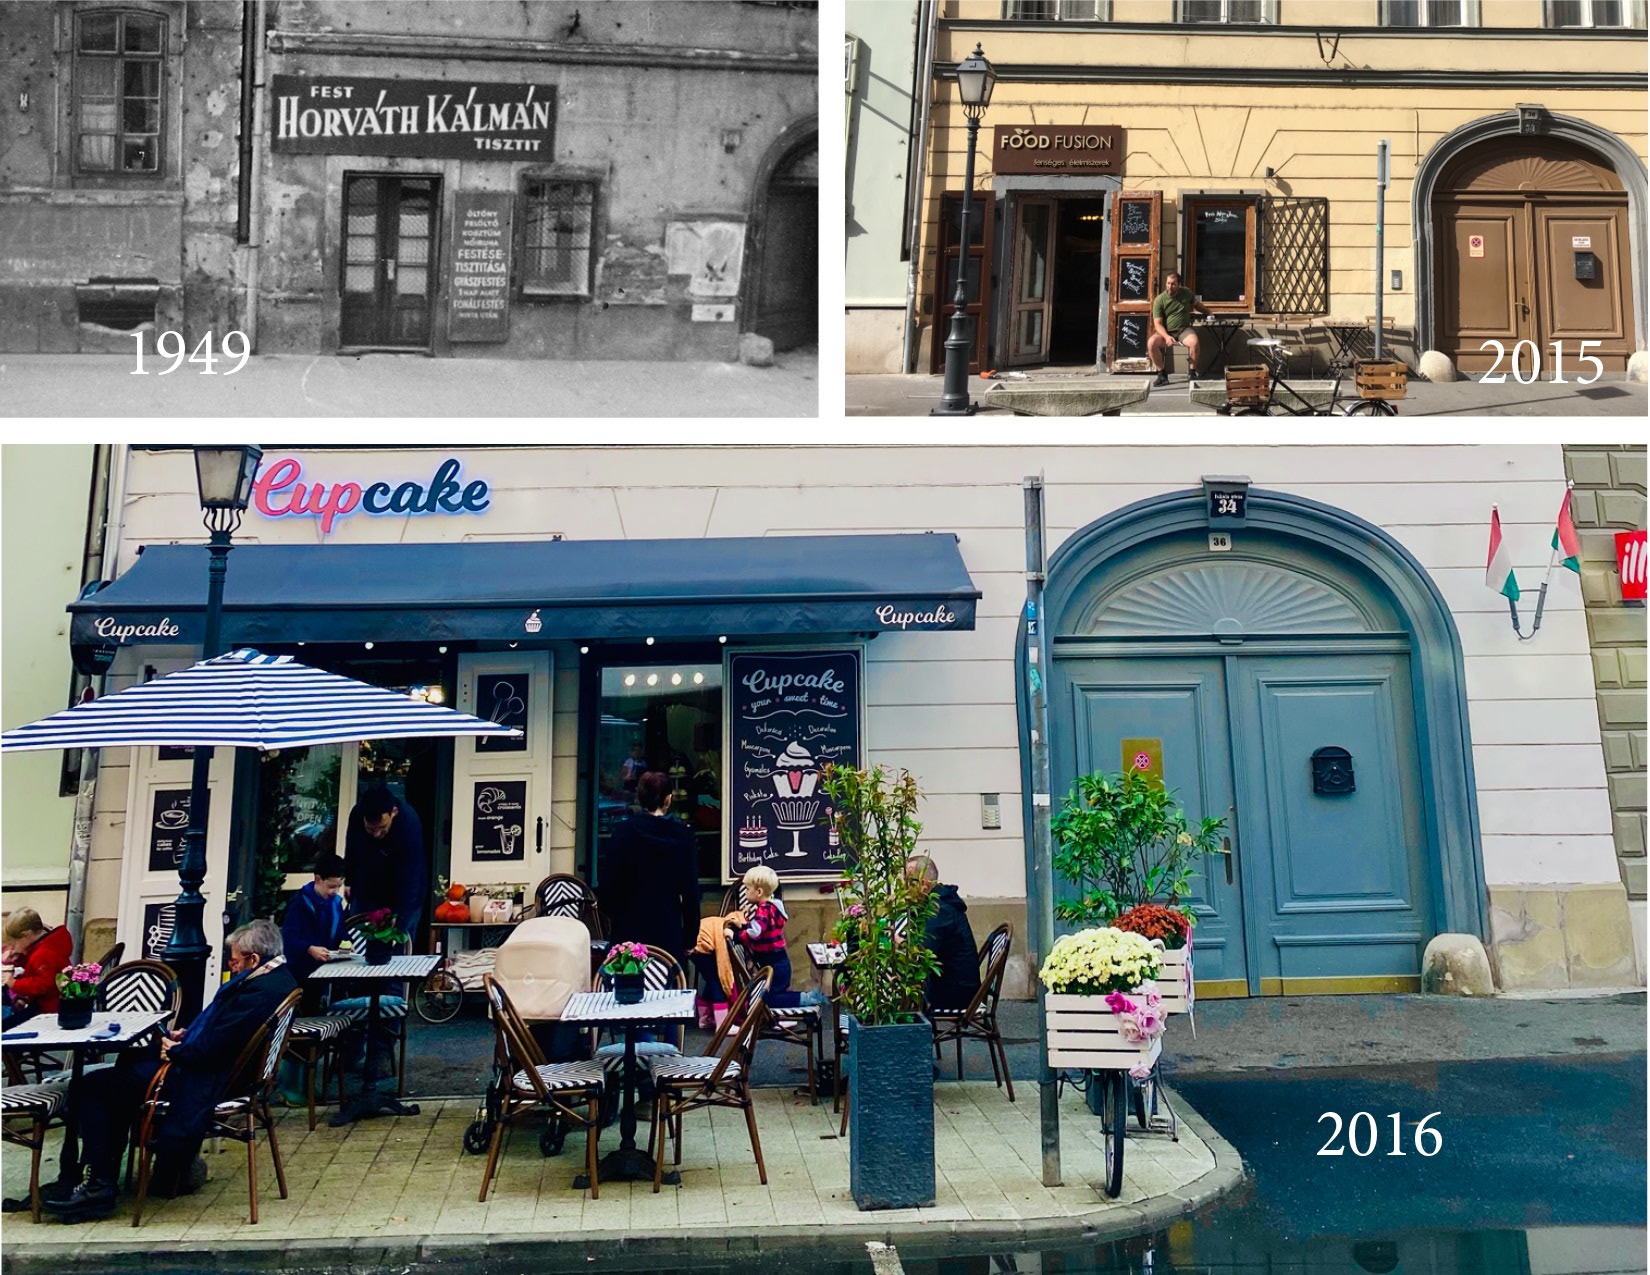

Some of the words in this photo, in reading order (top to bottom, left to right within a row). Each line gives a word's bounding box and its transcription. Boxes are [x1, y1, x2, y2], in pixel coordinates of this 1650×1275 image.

[310, 85, 354, 98] FEST
[277, 89, 420, 139] HORVÁTH
[425, 85, 551, 134] KÁLMÁN
[474, 137, 542, 152] TISZTIT
[1000, 134, 1050, 149] FOOD
[1054, 134, 1112, 149] FUSION
[455, 260, 507, 273] TISZTITÁSA
[454, 276, 506, 287] GYÁSZFESTÉS
[453, 298, 505, 309] FONÁLFESTÉS
[250, 458, 491, 534] Cupcake
[1218, 499, 1238, 514] 34
[1213, 537, 1226, 547] 36
[1621, 539, 1648, 593] ill
[875, 604, 956, 630] Cupcake
[94, 616, 179, 643] Cupcake
[742, 668, 845, 695] Cupcake
[751, 698, 772, 713] your
[783, 692, 809, 703] sweet
[819, 694, 839, 709] time
[297, 812, 322, 824] OPEN
[738, 851, 763, 866] Birthday
[763, 846, 780, 860] Cake
